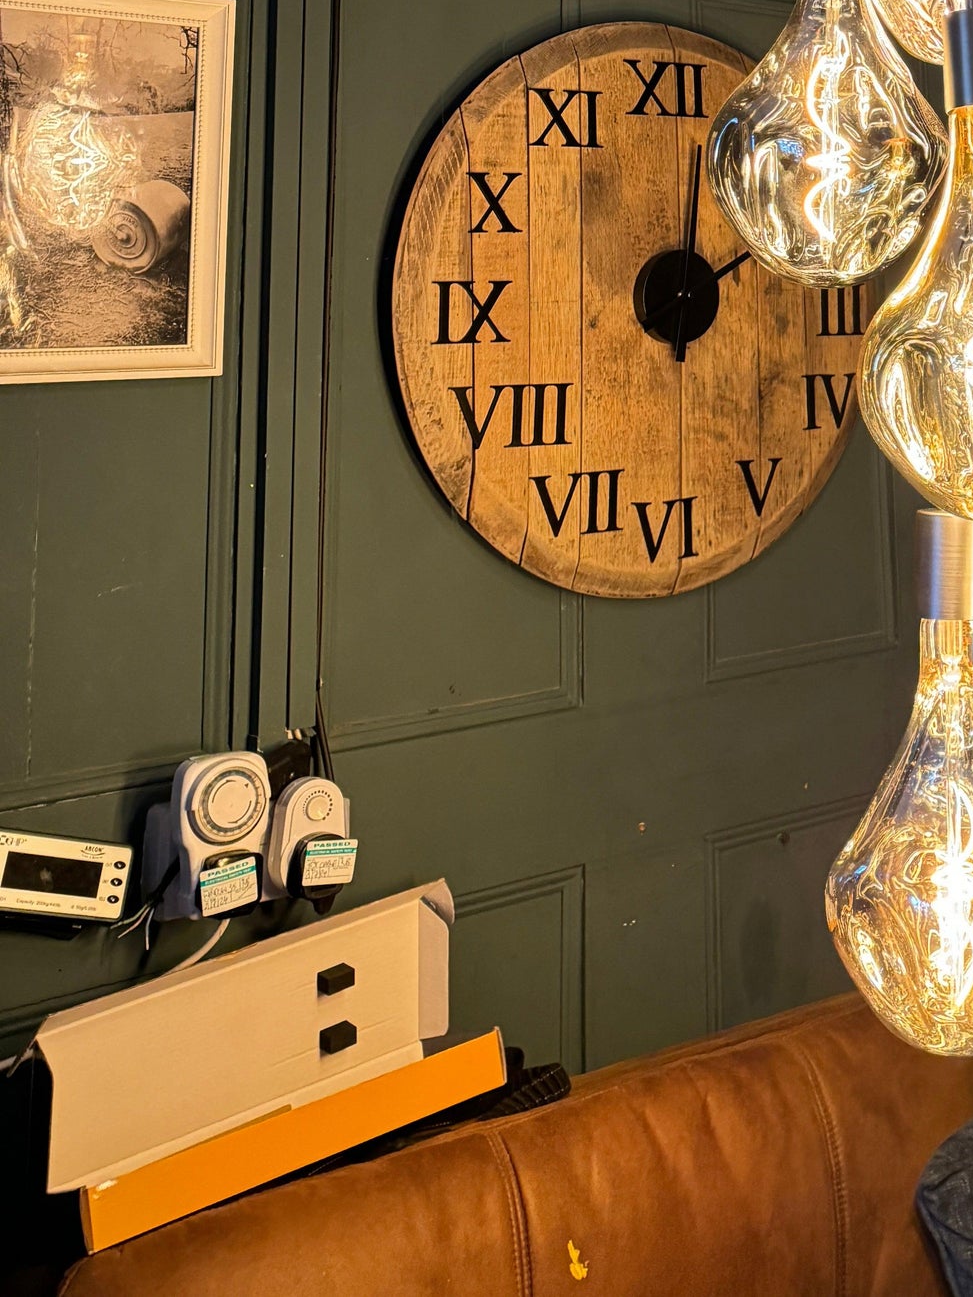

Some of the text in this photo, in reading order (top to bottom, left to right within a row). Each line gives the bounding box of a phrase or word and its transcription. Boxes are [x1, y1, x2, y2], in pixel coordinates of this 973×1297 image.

[529, 88, 604, 149] XI
[624, 59, 709, 119] XII
[466, 171, 523, 234] X
[431, 280, 512, 345] IX
[816, 283, 865, 337] III
[448, 382, 573, 449] VIII
[801, 373, 857, 431] IV
[529, 469, 625, 538] VII
[736, 457, 783, 517] V
[631, 496, 699, 564] VI
[207, 861, 249, 878] PASSED
